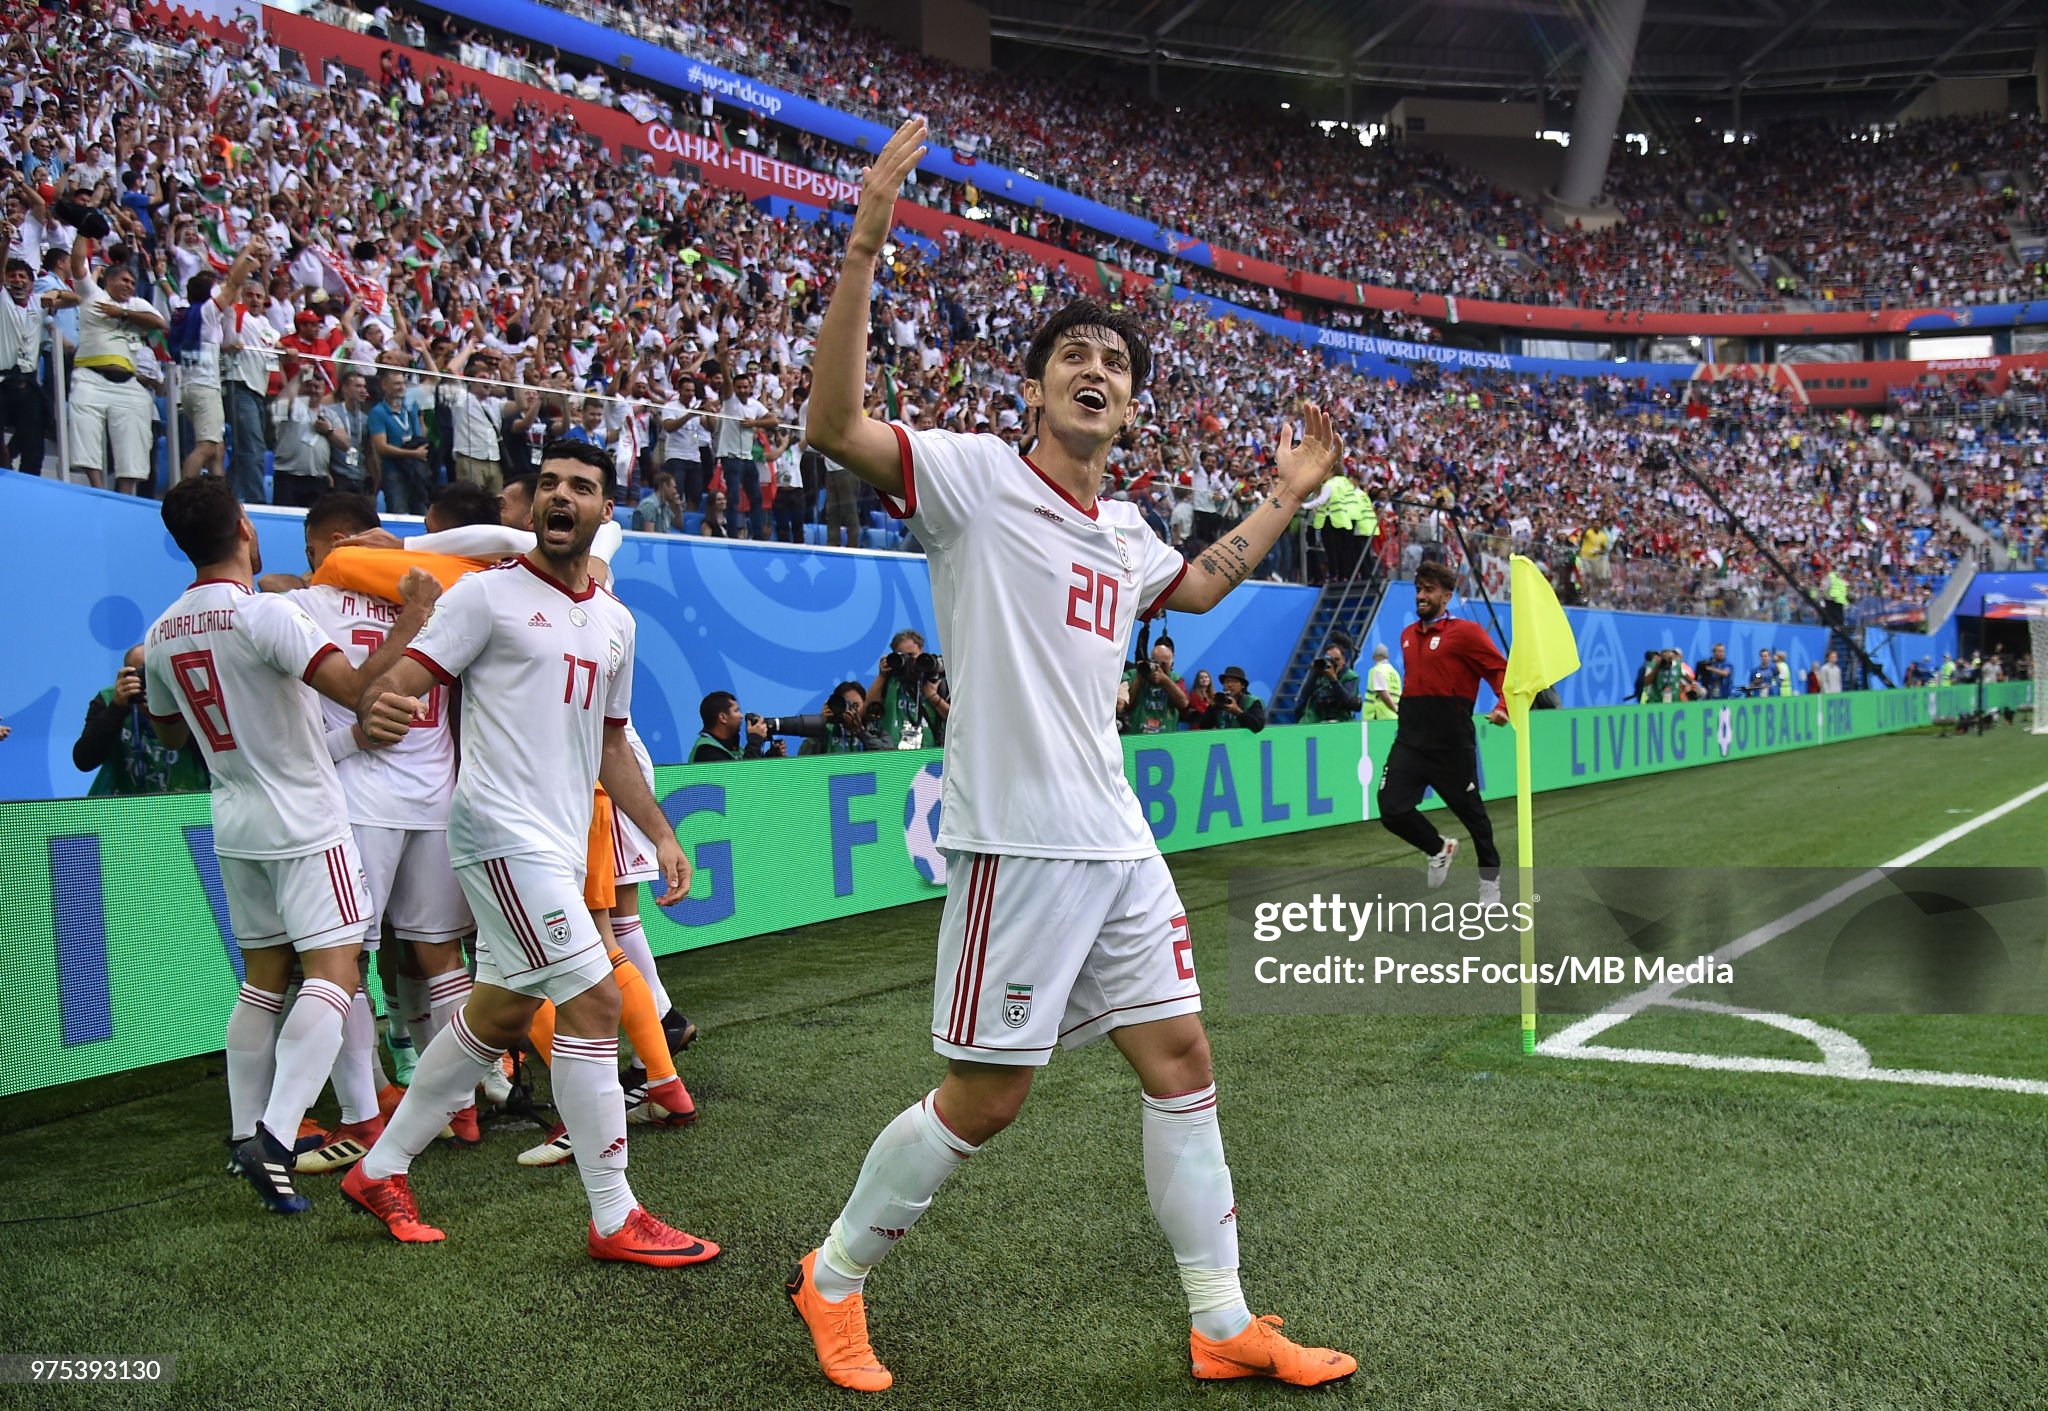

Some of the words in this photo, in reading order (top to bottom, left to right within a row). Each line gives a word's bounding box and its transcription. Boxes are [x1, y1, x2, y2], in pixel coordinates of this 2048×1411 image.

[1318, 328, 1347, 348] 2018
[1348, 335, 1376, 353] FIFA
[1377, 339, 1425, 360] WORLD
[1428, 346, 1456, 363] CUP
[1459, 350, 1511, 369] RUSSIA
[1033, 506, 1064, 523] adidas
[1066, 562, 1118, 642] 20
[170, 649, 237, 753] 8
[564, 653, 597, 710] 17
[1571, 709, 1687, 777] LIVING
[1703, 697, 1812, 757] FOOTBALL
